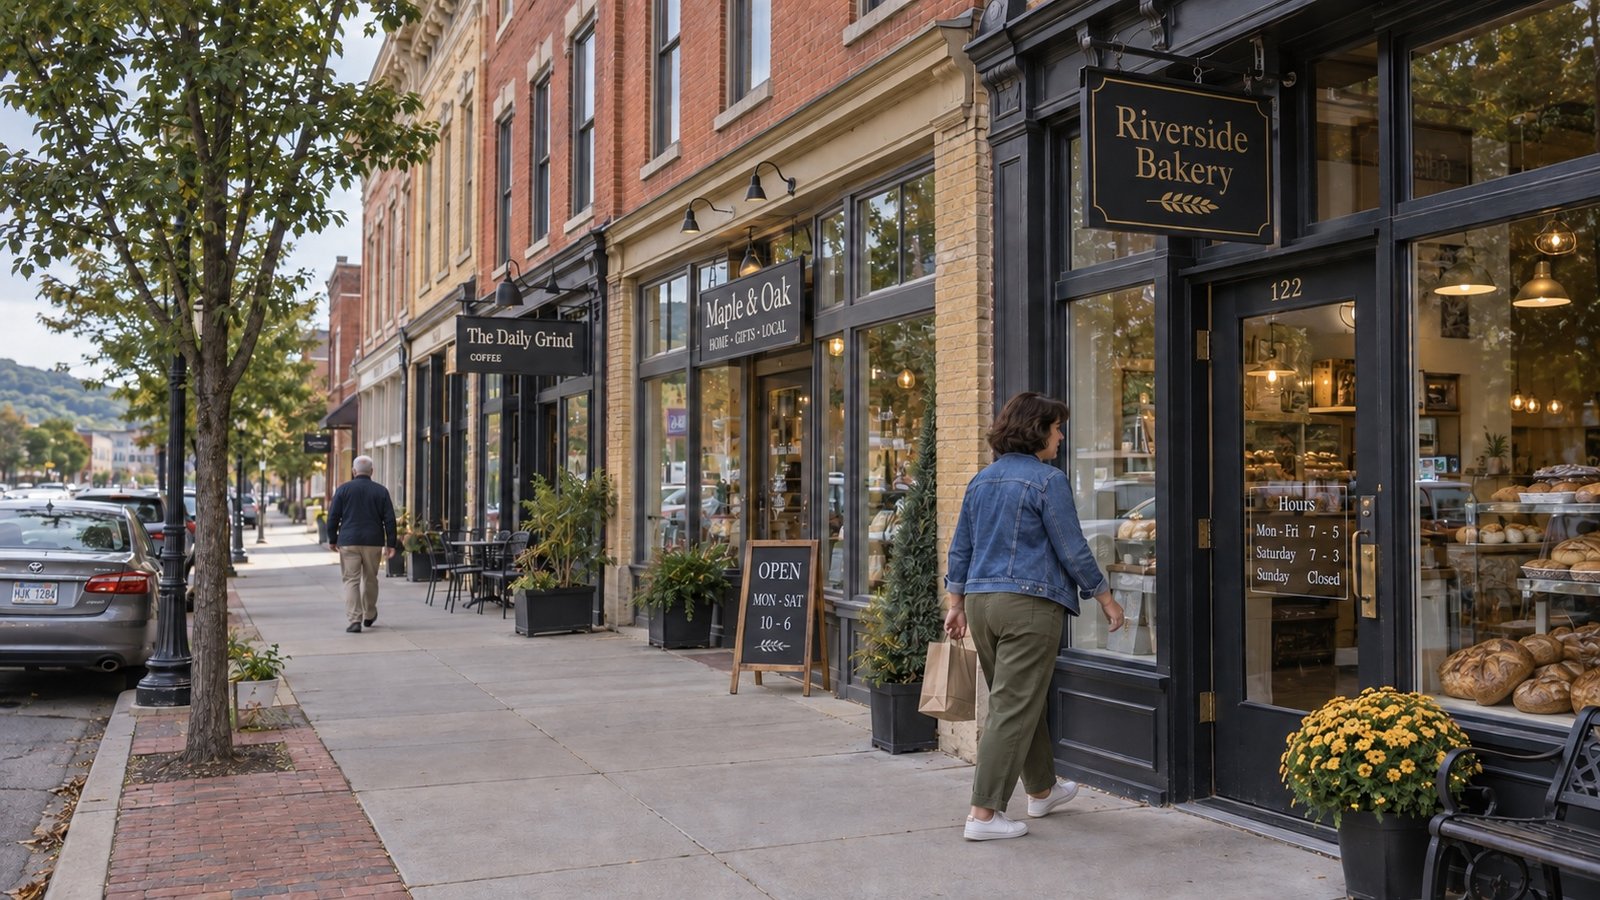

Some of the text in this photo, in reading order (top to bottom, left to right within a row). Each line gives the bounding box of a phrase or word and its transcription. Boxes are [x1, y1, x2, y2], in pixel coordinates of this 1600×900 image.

[1116, 105, 1248, 153] Riverside
[1136, 146, 1234, 195] Bakery
[1271, 278, 1302, 301] 122
[706, 276, 792, 330] Maple & Oak
[467, 328, 574, 350] The Daily Grind
[709, 335, 728, 351] HOME
[735, 328, 756, 344] GIFTS
[762, 320, 786, 338] LOCAL
[470, 353, 502, 362] COFFEE
[1278, 496, 1316, 512] Hours
[1256, 524, 1276, 537] Mon
[1285, 524, 1299, 538] Fri
[1309, 525, 1316, 538] 7
[1332, 526, 1340, 538] 5
[1256, 546, 1296, 564] Saturday
[1309, 548, 1316, 561] 7
[1332, 550, 1340, 562] 3
[758, 562, 802, 580] OPEN
[1257, 568, 1340, 586] Sunday Closed
[752, 593, 776, 606] MON
[784, 594, 804, 608] SAT
[760, 616, 773, 630] 10
[784, 616, 792, 630] 6
